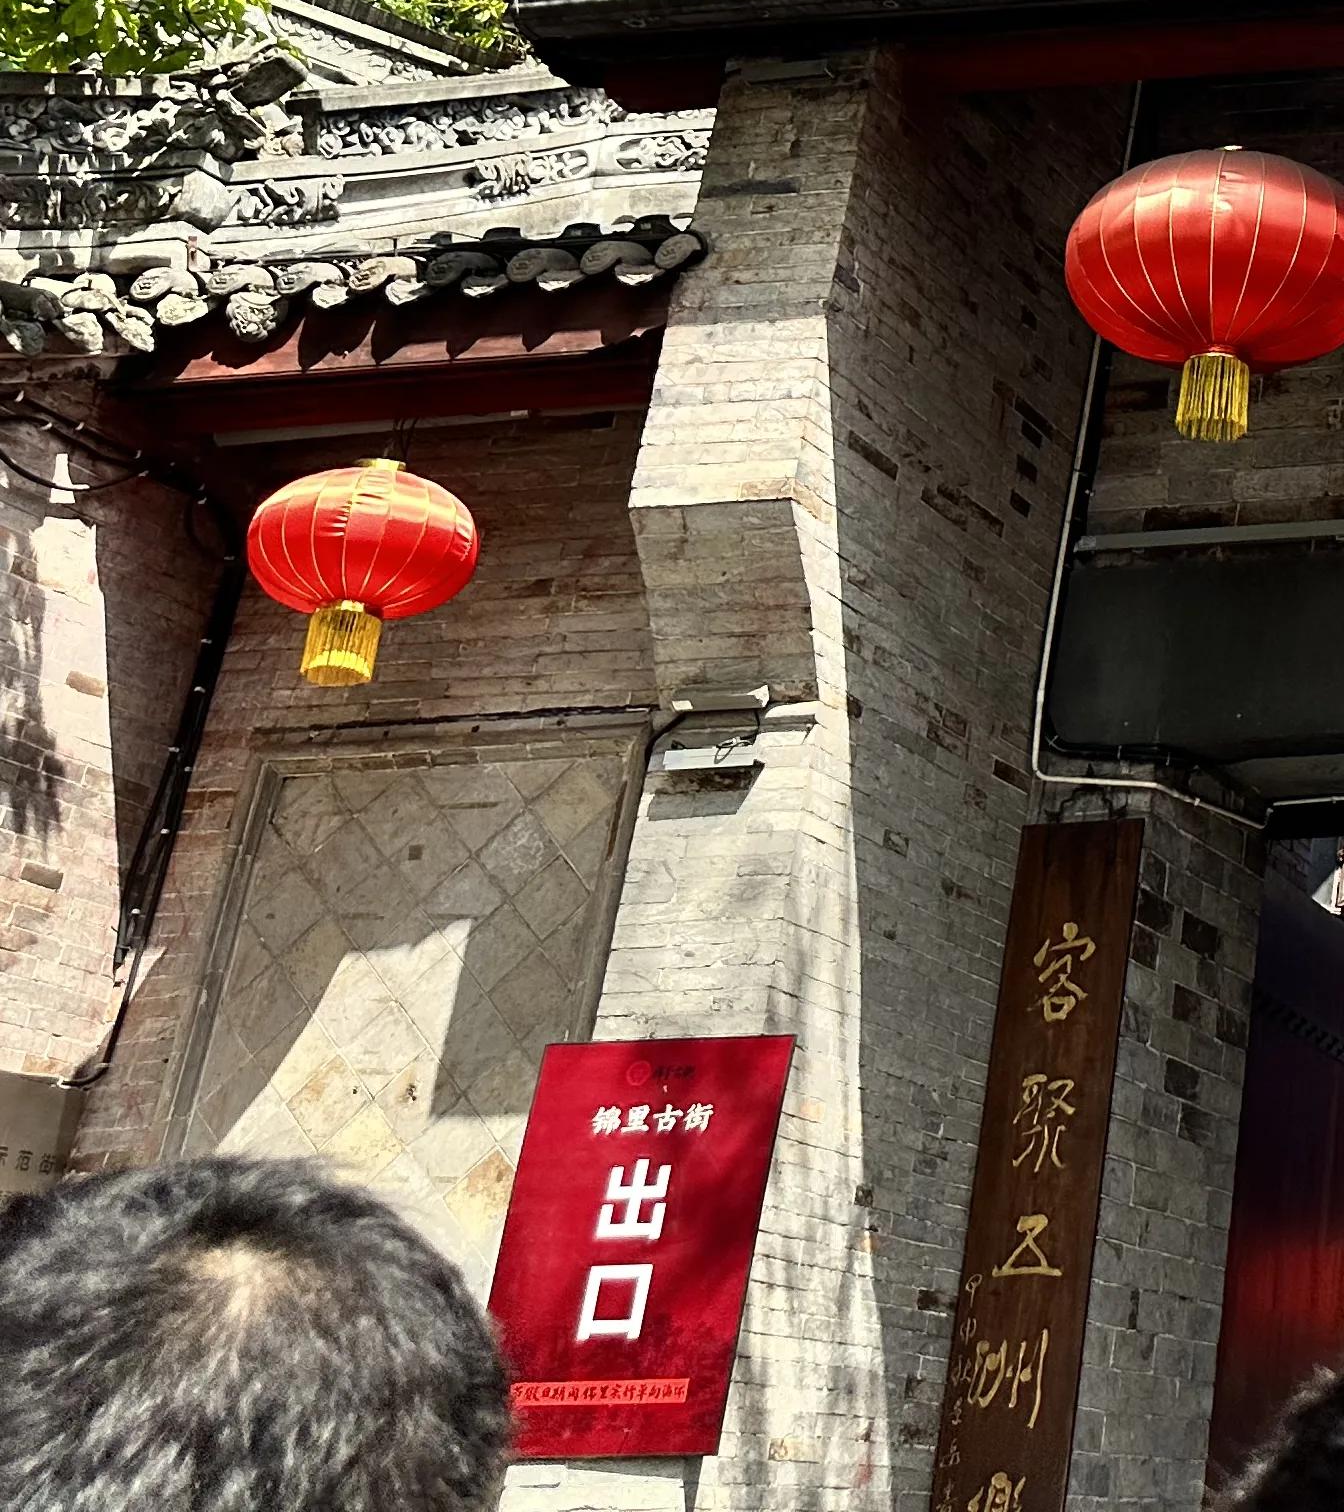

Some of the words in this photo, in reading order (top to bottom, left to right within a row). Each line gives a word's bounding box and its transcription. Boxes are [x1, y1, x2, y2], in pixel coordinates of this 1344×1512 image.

[591, 1102, 714, 1136] 锦里古街
[576, 1158, 673, 1342] 出口
